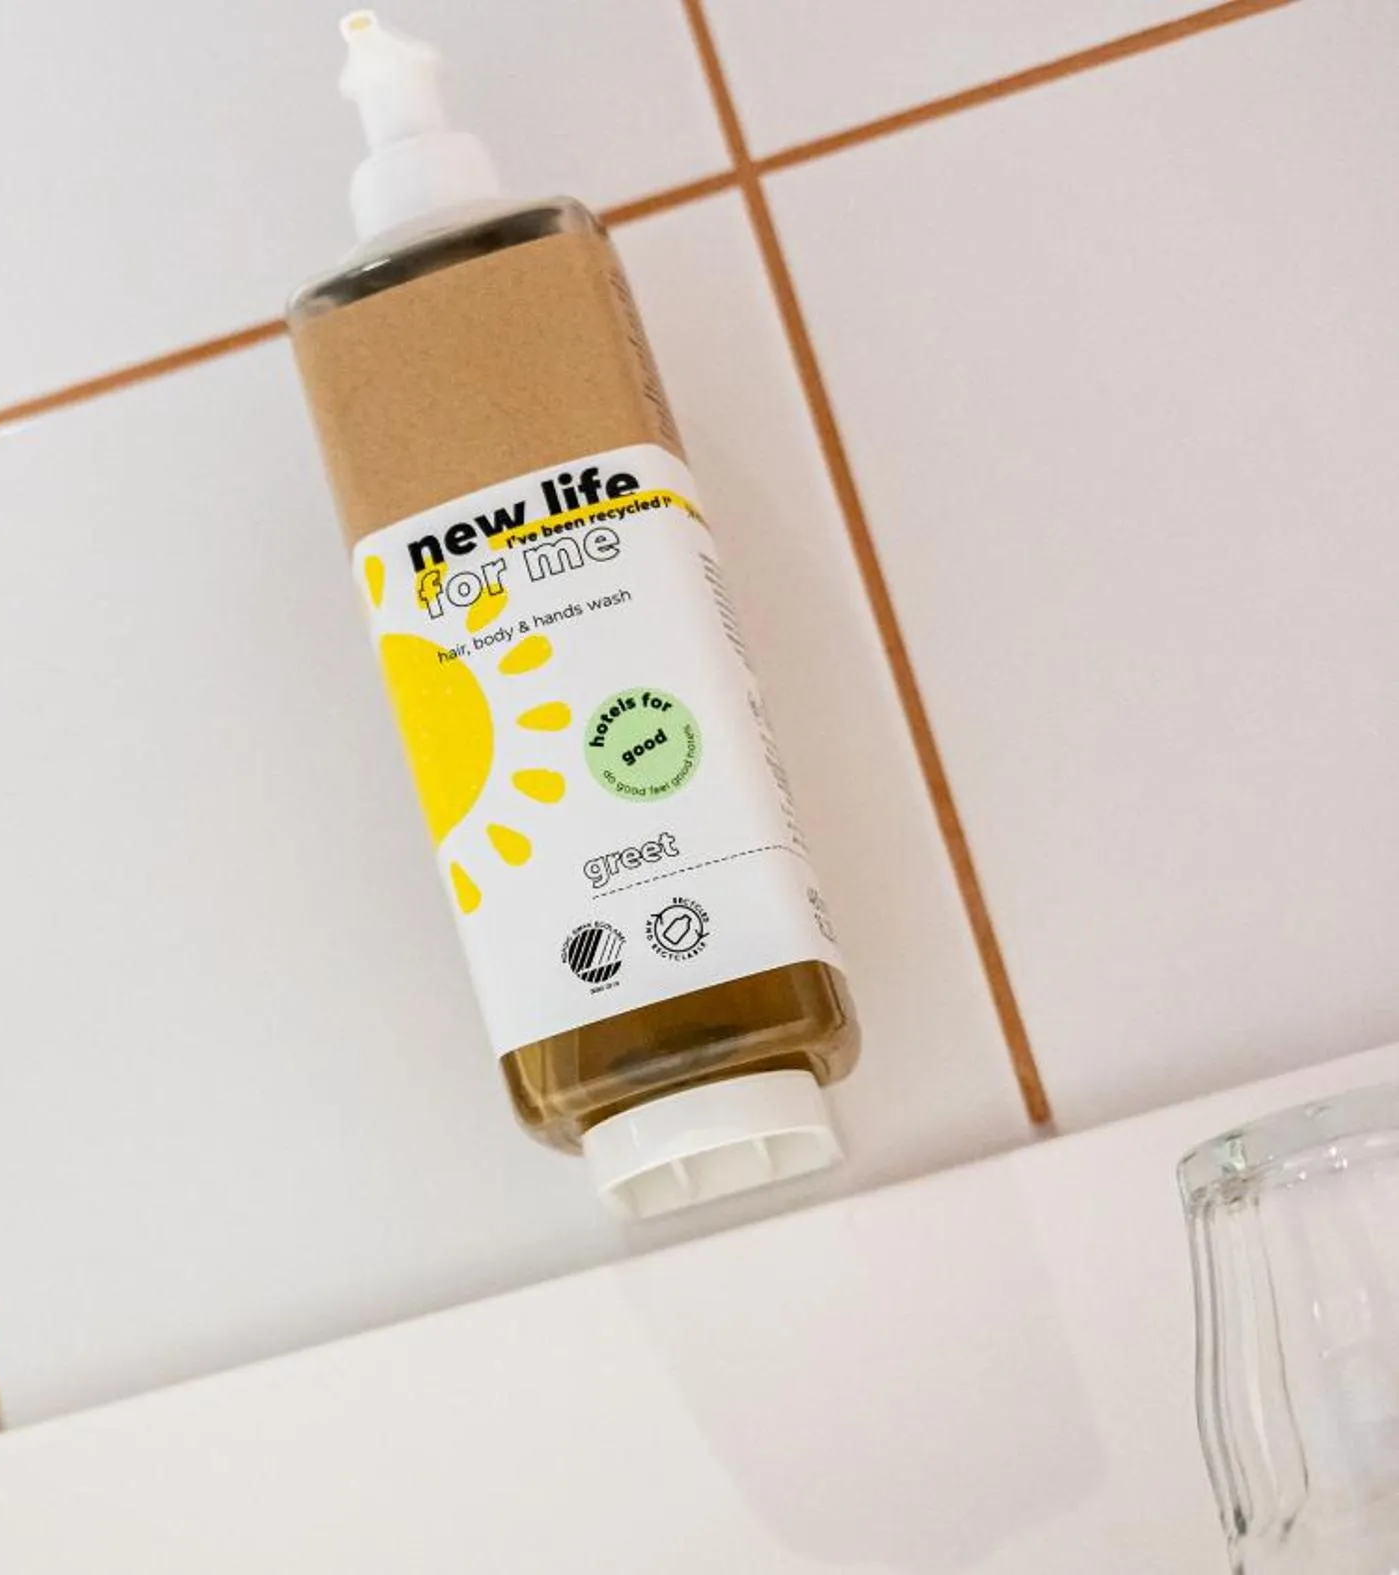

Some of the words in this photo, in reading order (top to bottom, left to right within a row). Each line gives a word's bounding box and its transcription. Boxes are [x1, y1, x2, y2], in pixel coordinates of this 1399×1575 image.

[407, 500, 526, 573] new
[541, 467, 640, 516] life
[506, 531, 537, 549] I've
[540, 517, 585, 538] been
[589, 495, 661, 523] recycled
[418, 557, 507, 620] for
[523, 526, 621, 583] me
[437, 642, 471, 665] hair,
[473, 626, 514, 651] body
[519, 620, 531, 634] &
[532, 604, 583, 628] hands
[586, 588, 632, 612] wash
[588, 697, 637, 748] hotels
[642, 691, 673, 712] for
[621, 727, 668, 766] good
[603, 769, 616, 785] do
[616, 781, 646, 796] good
[583, 831, 680, 888] greet
